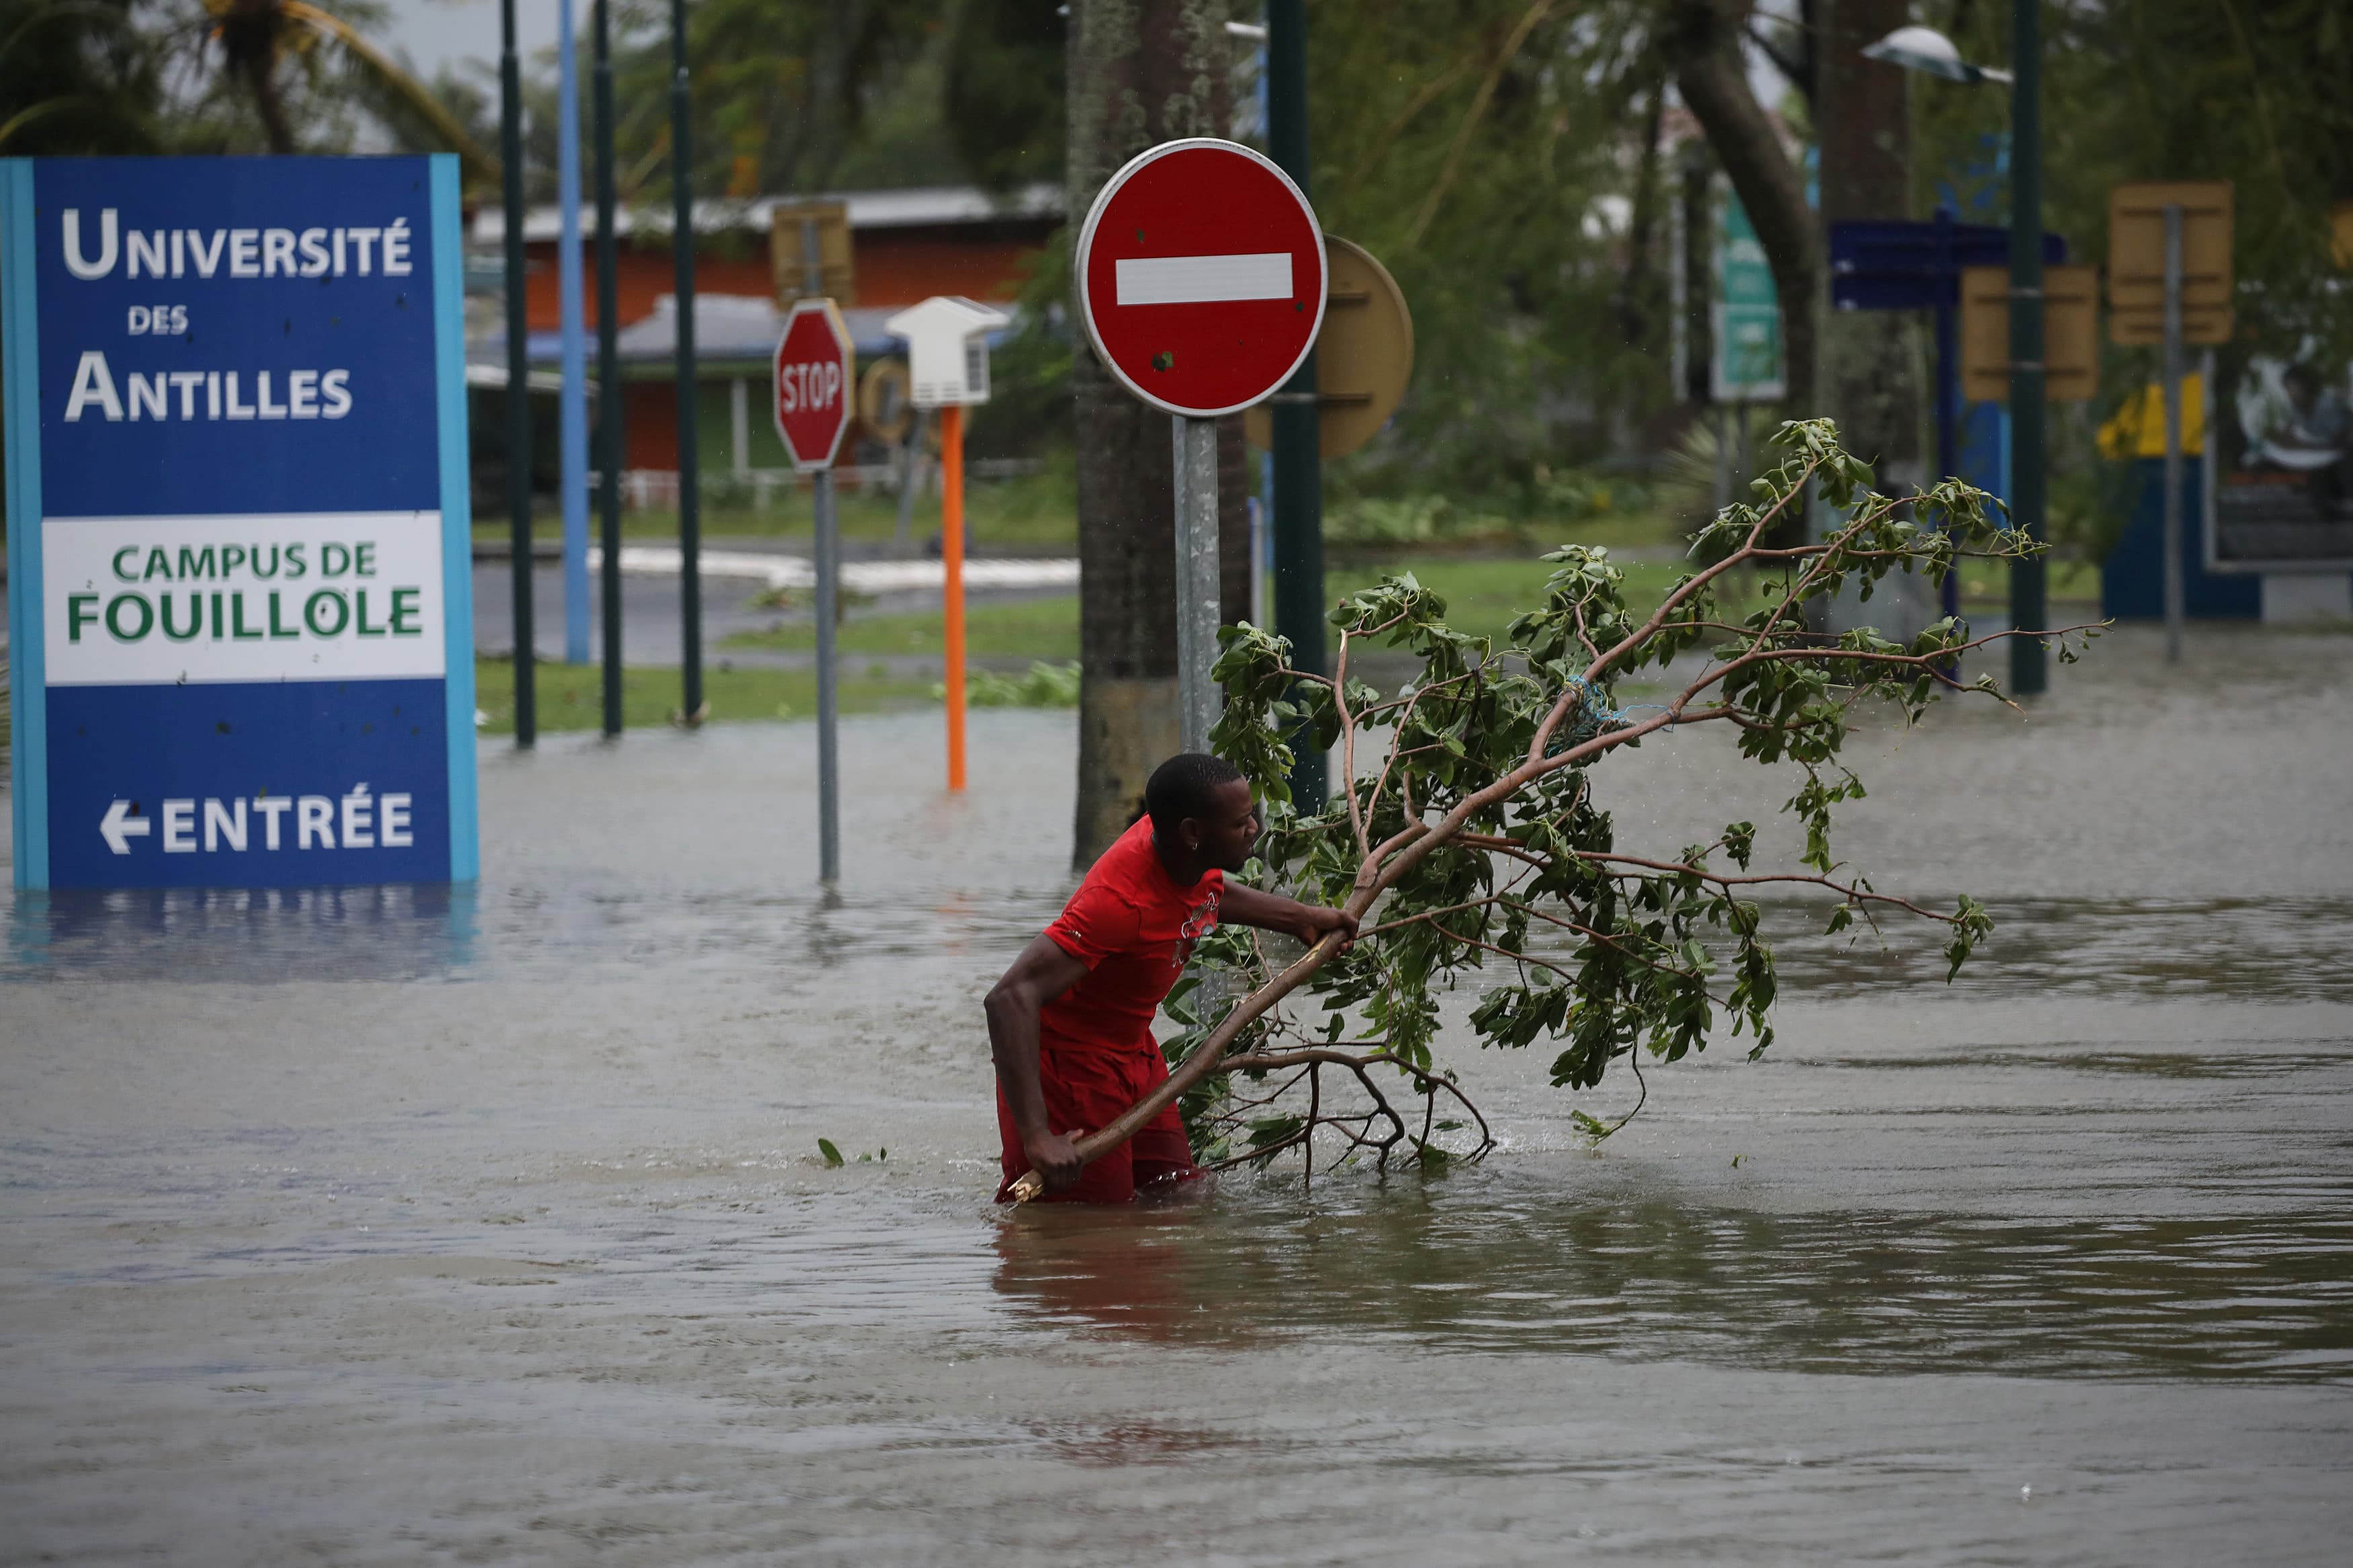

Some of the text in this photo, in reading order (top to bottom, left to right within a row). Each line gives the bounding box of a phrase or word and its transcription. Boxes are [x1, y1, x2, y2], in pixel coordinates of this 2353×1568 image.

[128, 304, 189, 335] DES
[64, 350, 353, 422] ANTILLES
[782, 361, 840, 413] STOP
[112, 541, 376, 583] CAMPUS DE
[67, 586, 423, 645] FOUILLOLE
[162, 782, 413, 854] ENTRÉE
